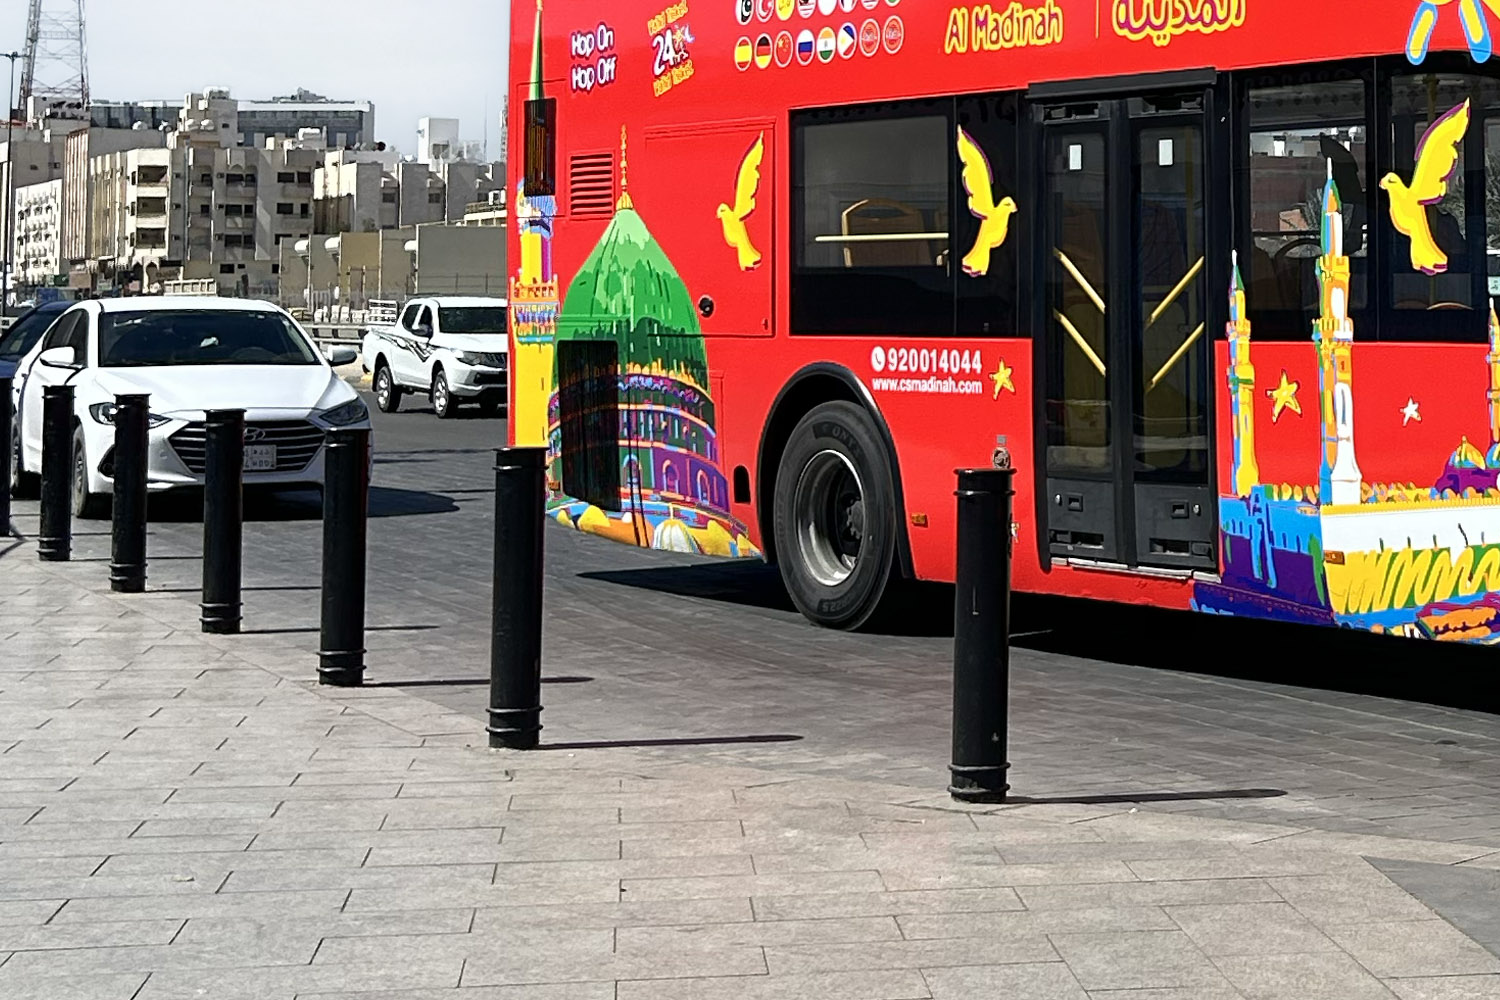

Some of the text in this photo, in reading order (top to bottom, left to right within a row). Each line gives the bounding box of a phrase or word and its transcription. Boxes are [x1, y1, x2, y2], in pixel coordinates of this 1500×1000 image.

[571, 23, 614, 57] Hop On
[944, 6, 968, 54] Al
[652, 28, 675, 76] 24
[571, 56, 618, 91] Hop Off
[887, 346, 983, 374] 920014044
[872, 376, 983, 395] www.csmadinah.com
